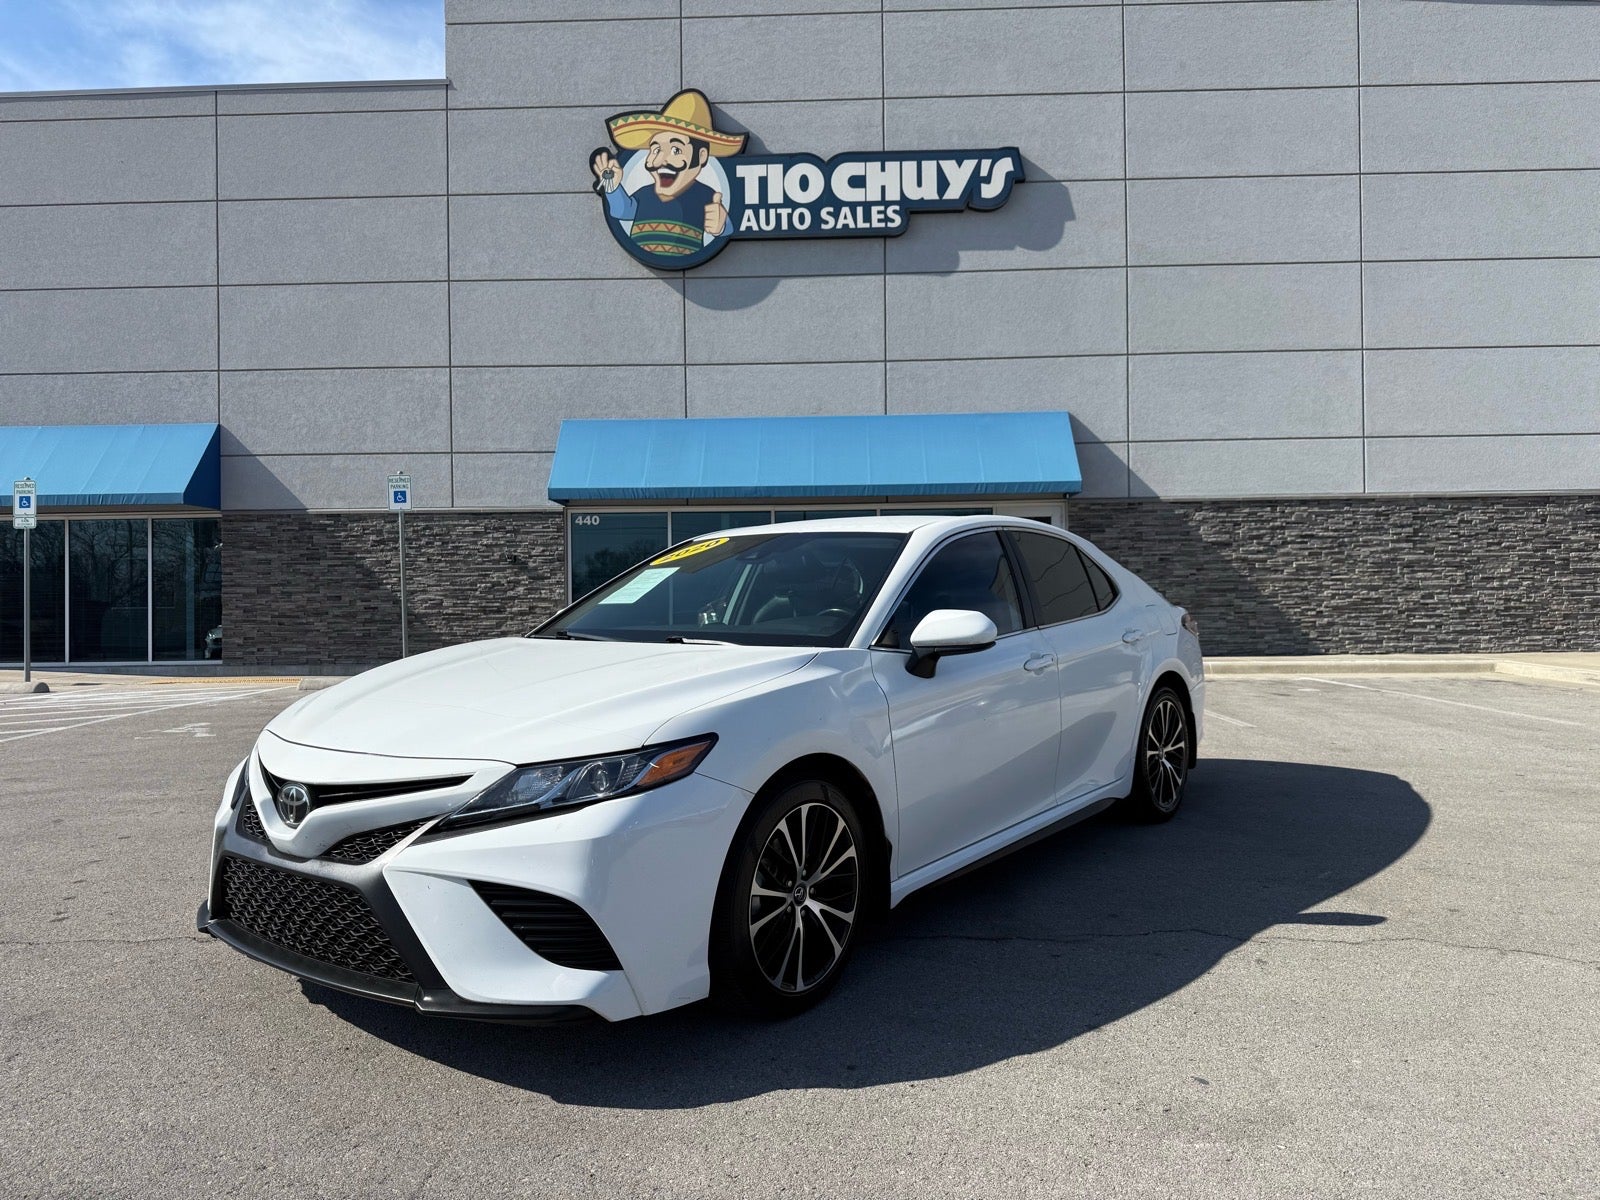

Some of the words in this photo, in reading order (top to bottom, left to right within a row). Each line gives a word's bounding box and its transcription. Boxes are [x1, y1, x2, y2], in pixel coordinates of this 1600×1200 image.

[736, 162, 825, 205] TIO
[830, 157, 1015, 202] CHUY'S
[739, 207, 812, 231] AUTO
[820, 205, 902, 230] SALES
[575, 515, 600, 526] 440
